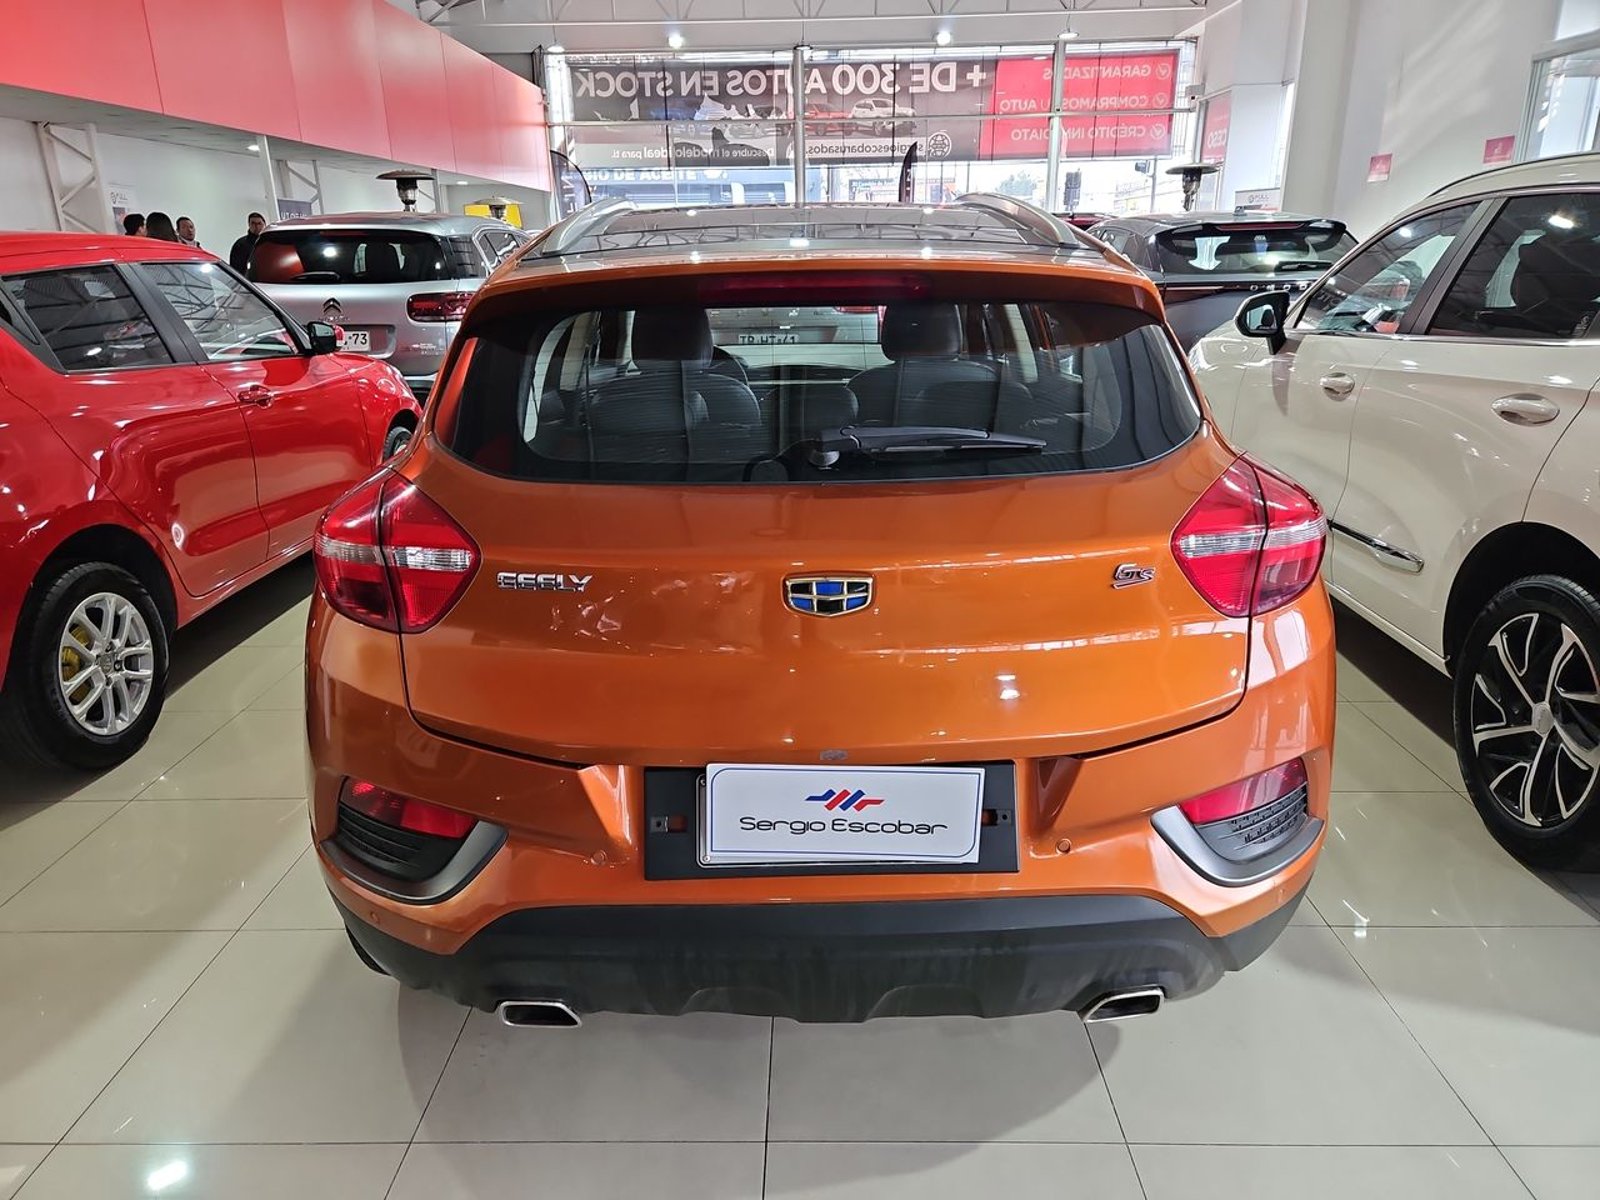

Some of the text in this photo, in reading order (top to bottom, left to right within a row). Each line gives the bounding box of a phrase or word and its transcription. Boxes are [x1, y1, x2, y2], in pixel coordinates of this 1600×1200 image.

[496, 571, 593, 592] GEELY
[739, 816, 948, 835] Sergio Escobar
